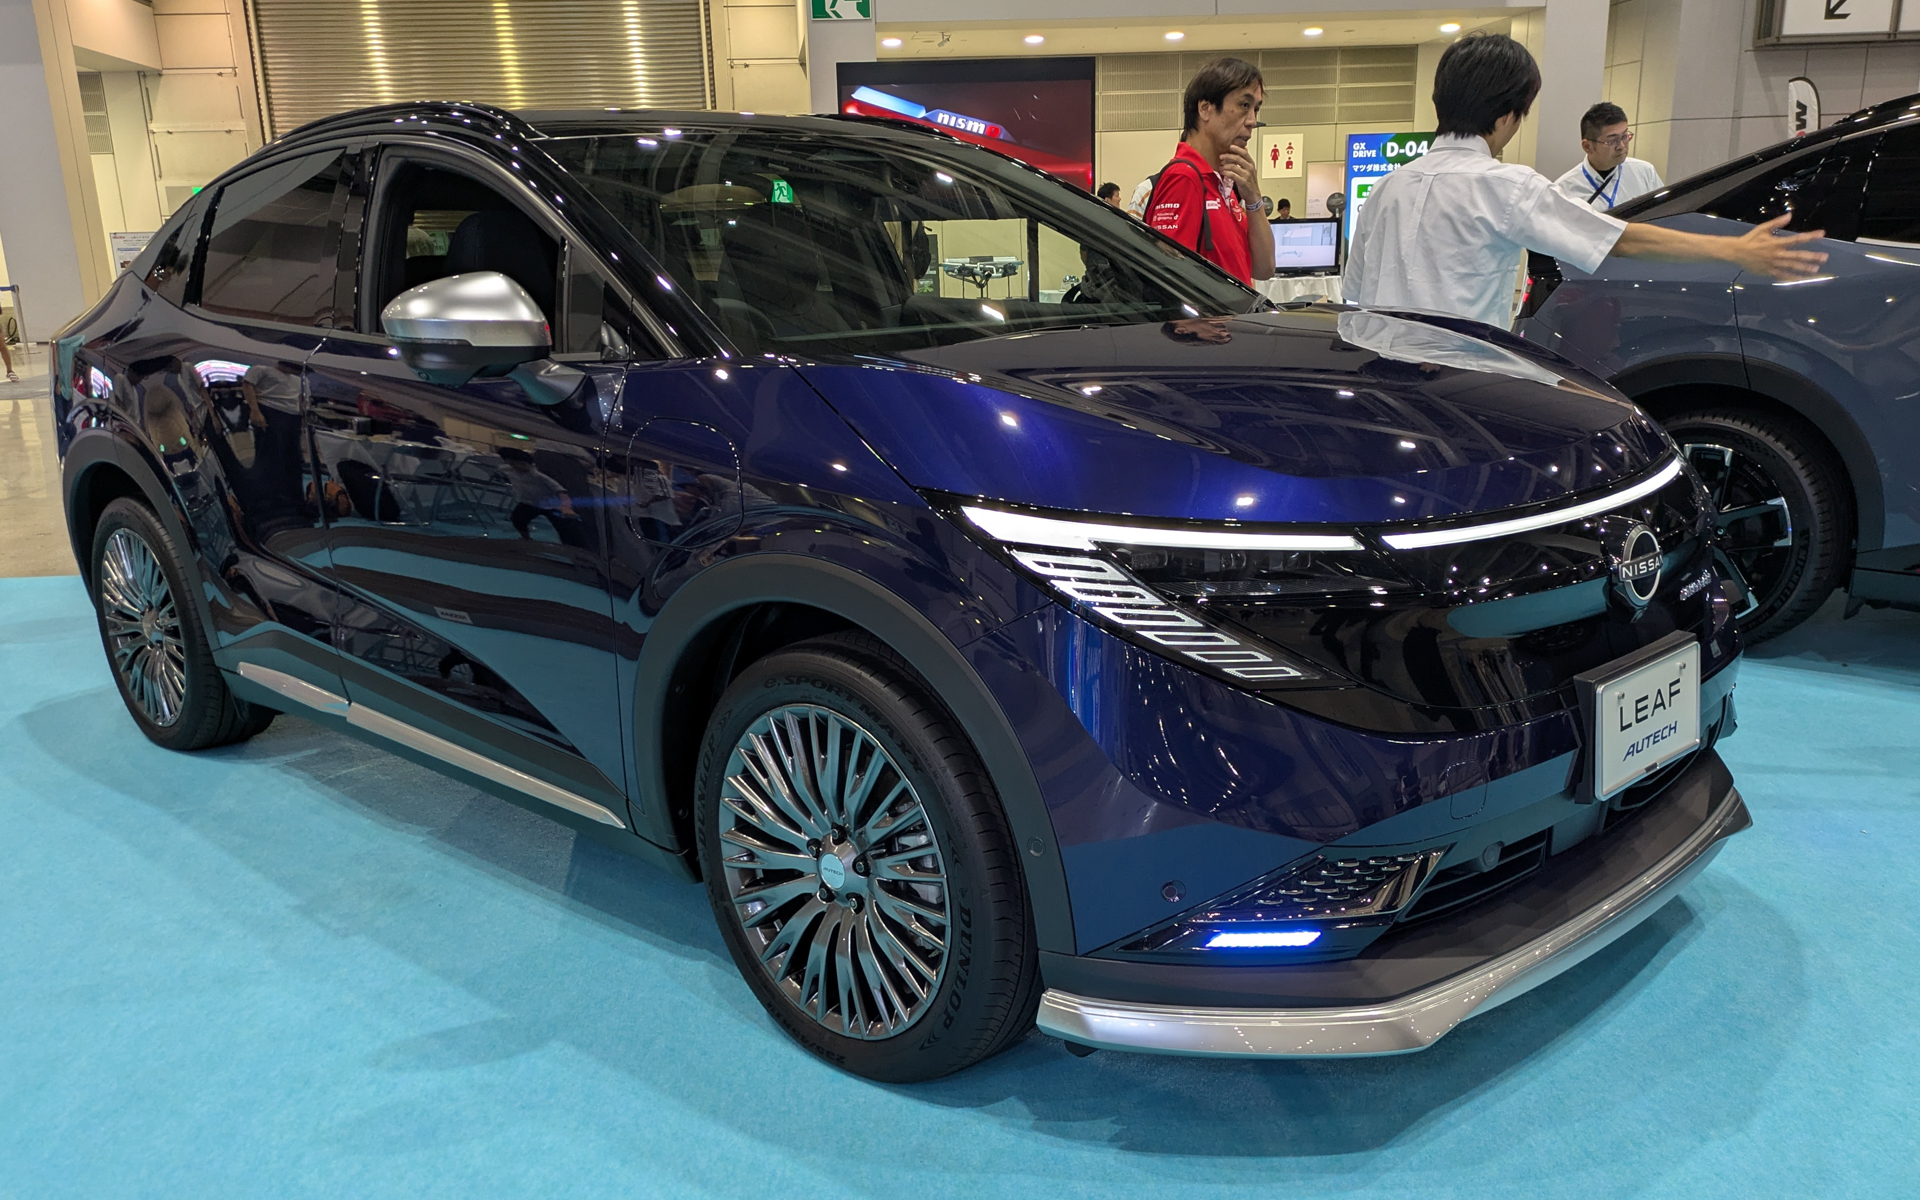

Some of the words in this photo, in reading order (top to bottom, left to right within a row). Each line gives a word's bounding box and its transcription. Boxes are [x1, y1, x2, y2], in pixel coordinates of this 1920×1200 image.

[1352, 142, 1366, 150] GX
[1352, 149, 1377, 158] DRIVE
[1386, 140, 1429, 157] D-04
[1620, 677, 1681, 732] LEAF
[1622, 720, 1678, 762] AUTECH
[697, 735, 716, 848] DUNLOP
[942, 907, 973, 1031] DUNLOP
